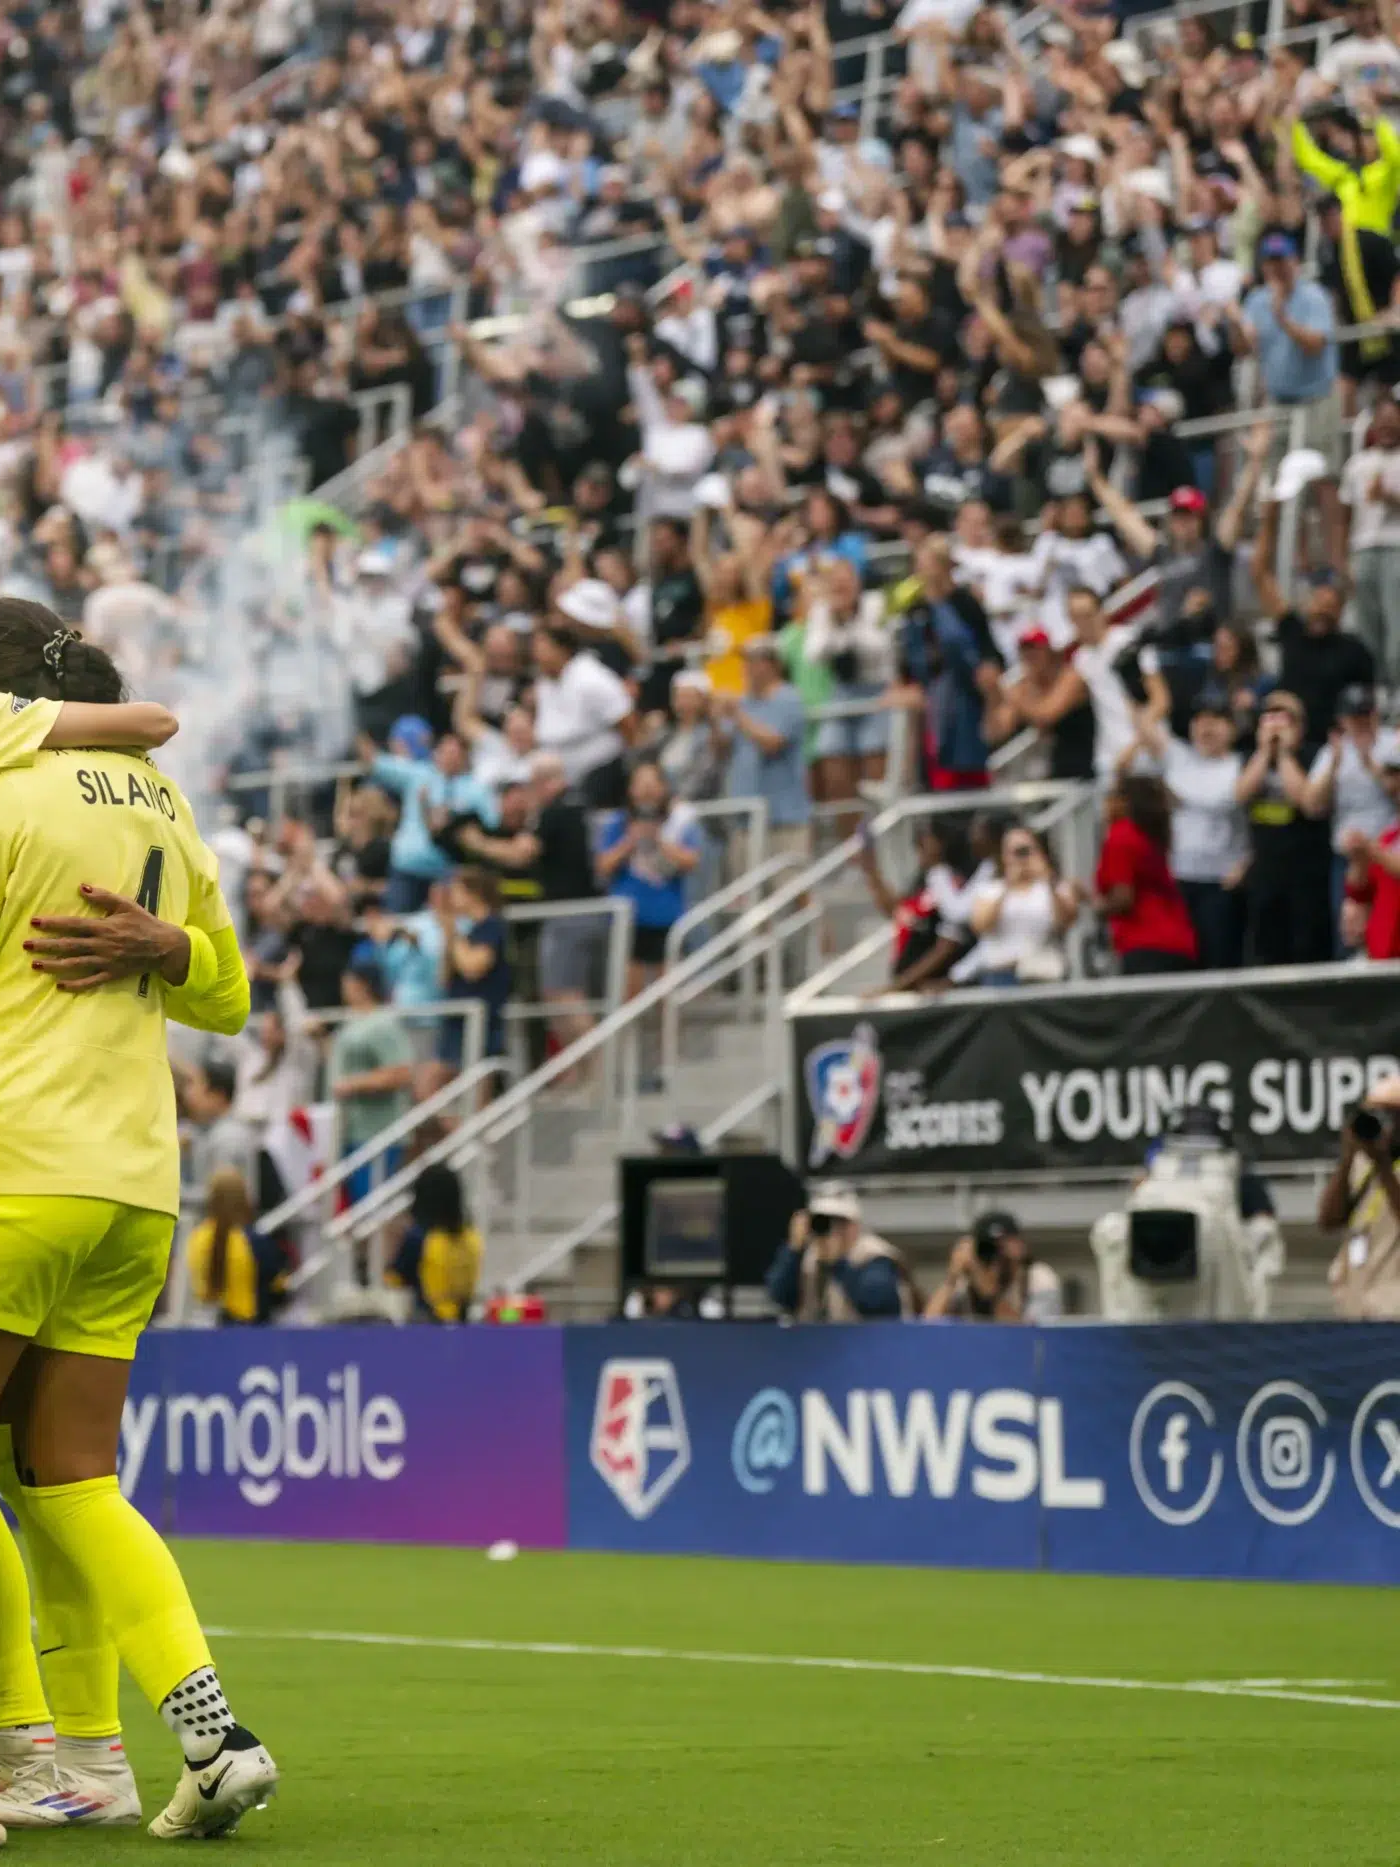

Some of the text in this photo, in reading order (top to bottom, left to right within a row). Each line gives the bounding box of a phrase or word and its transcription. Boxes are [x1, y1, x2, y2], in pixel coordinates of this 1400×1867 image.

[76, 768, 176, 822] SILANO
[1020, 1061, 1235, 1142] YOUNG
[731, 1387, 1106, 1509] @NWSL
